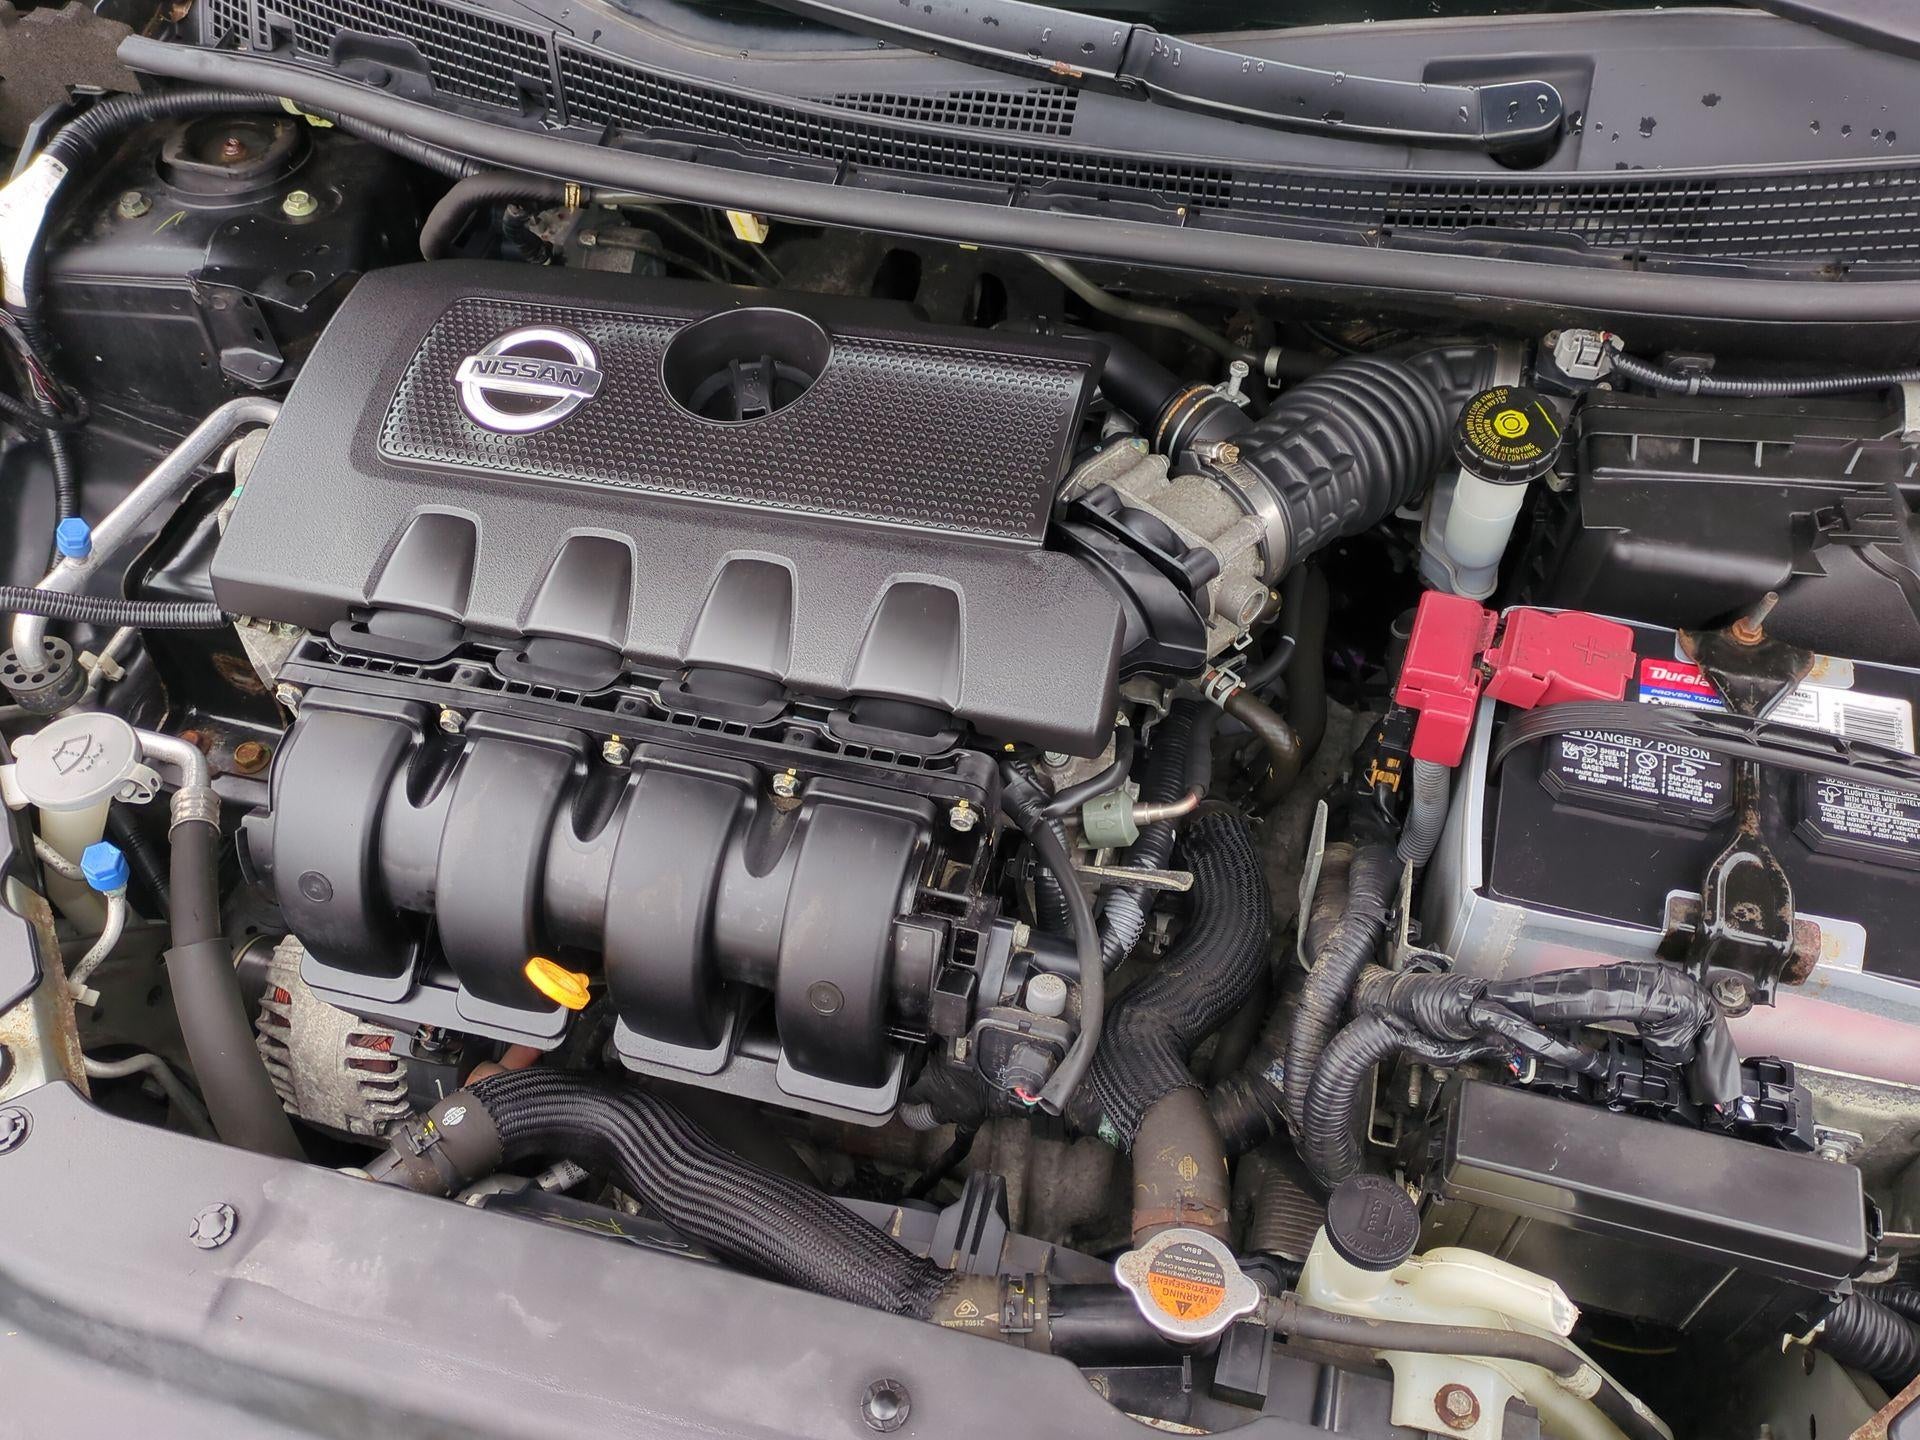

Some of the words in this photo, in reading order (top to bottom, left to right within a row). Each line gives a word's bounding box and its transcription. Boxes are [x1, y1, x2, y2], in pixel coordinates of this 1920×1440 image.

[470, 360, 584, 386] NISSAN
[1480, 393, 1495, 403] ONLY
[1507, 447, 1542, 461] CONTAINER
[1484, 419, 1500, 443] WARNING
[1488, 396, 1506, 407] CLEAN
[1501, 442, 1535, 453] REMOVING
[1651, 689, 1692, 699] PROVEN
[1584, 730, 1641, 747] DANGER
[1658, 742, 1710, 760] POISON
[1600, 748, 1625, 757] SHIELD
[1581, 763, 1604, 772] GASES
[1582, 757, 1619, 769] EXPLOSIVE
[1668, 773, 1702, 786] SULFURIC
[1704, 781, 1721, 789] ACID
[1844, 788, 1863, 797] FLUSH
[1864, 792, 1880, 800] EYES
[1844, 795, 1859, 803] WITH
[1885, 801, 1897, 809] GET
[1872, 806, 1887, 815] HELP
[1153, 1276, 1220, 1295] AVERTISSEMENT
[1163, 1288, 1207, 1303] WARNING
